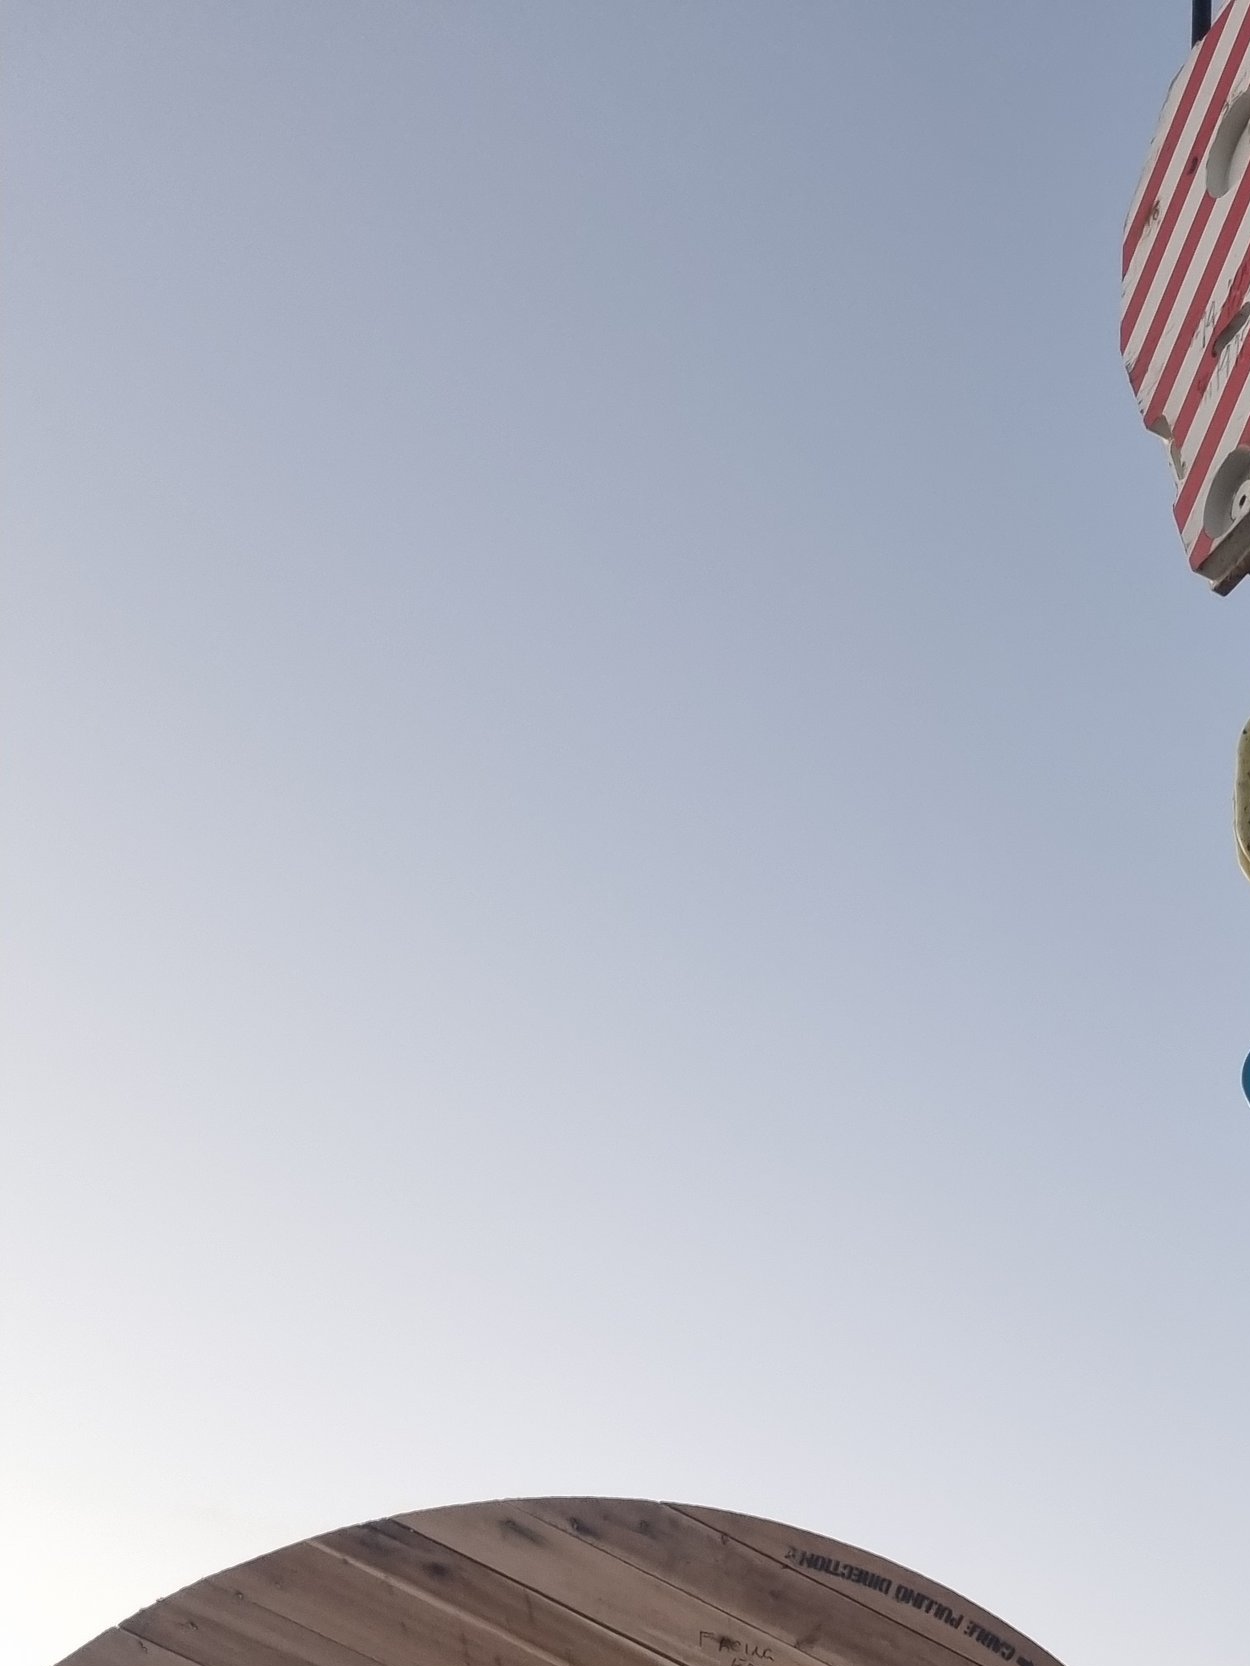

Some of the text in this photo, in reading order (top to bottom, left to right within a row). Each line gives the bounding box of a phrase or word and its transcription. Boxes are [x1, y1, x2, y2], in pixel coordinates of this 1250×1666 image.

[800, 1551, 1016, 1662] CABLE PULLING DIRECTION
